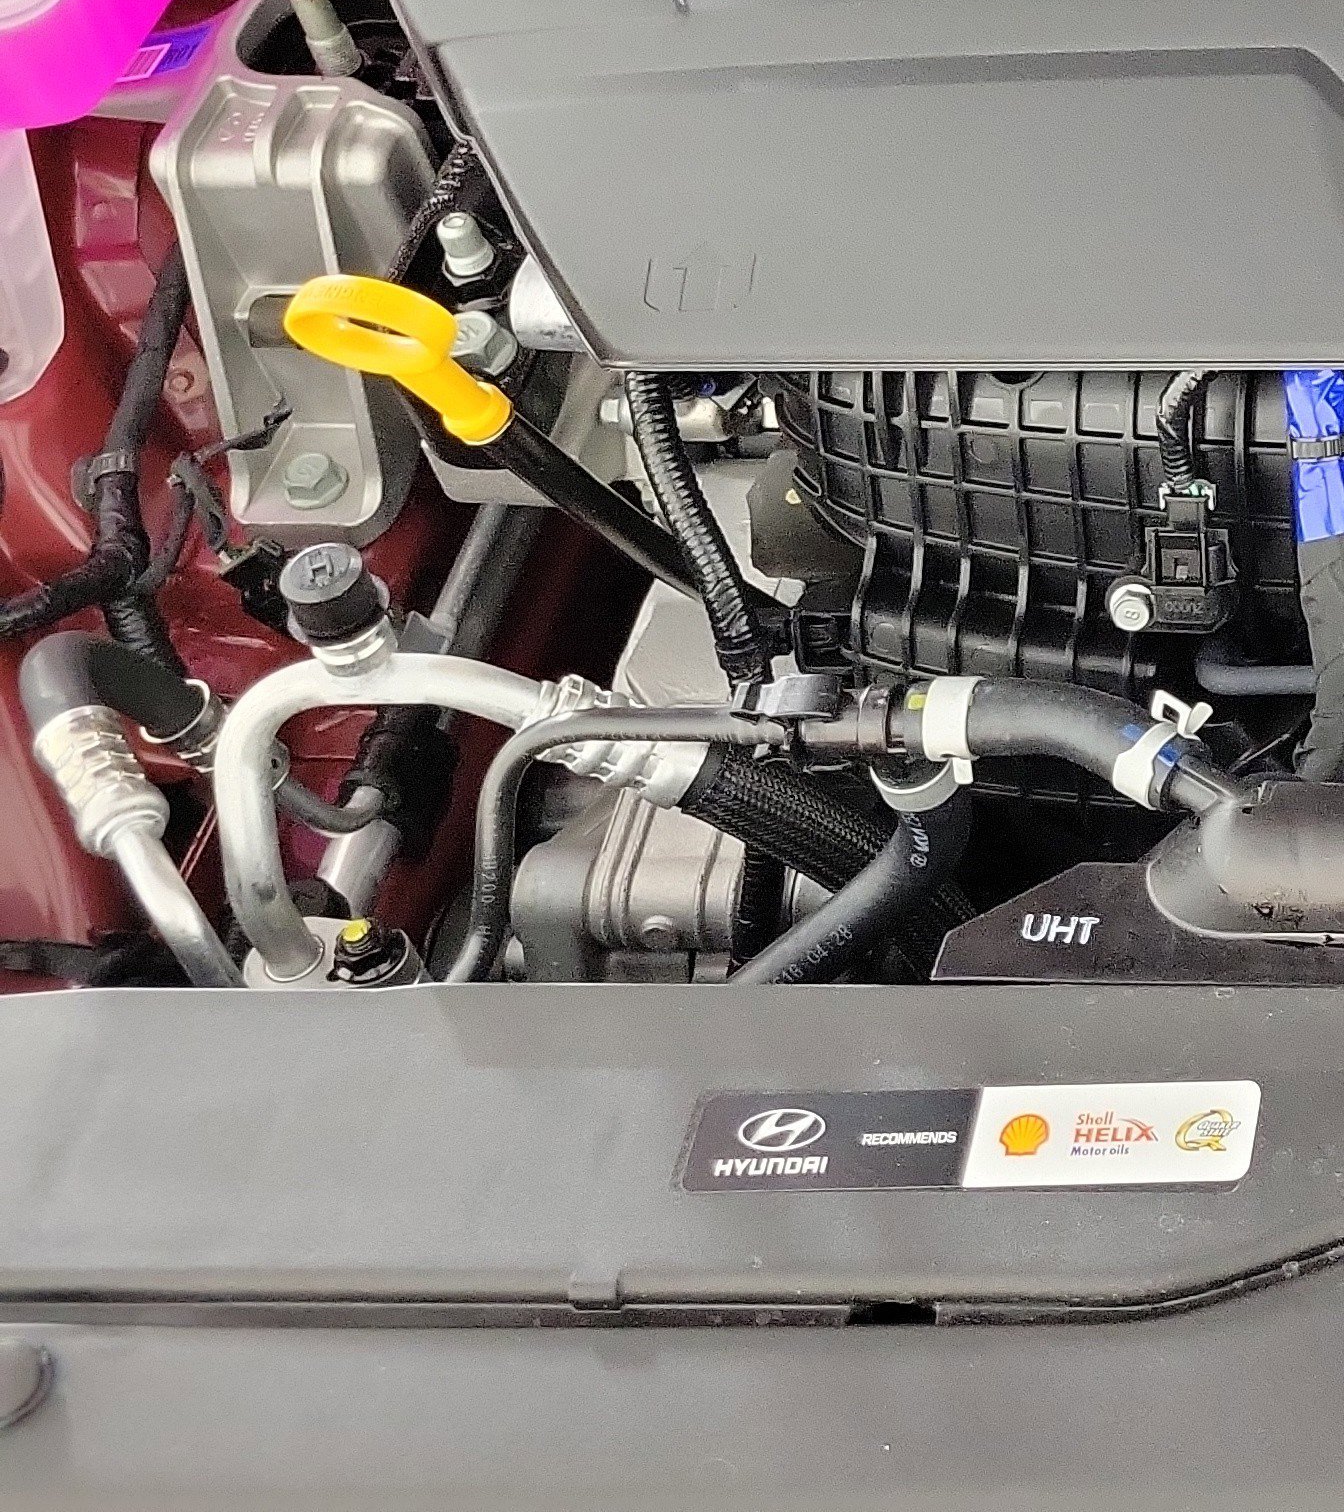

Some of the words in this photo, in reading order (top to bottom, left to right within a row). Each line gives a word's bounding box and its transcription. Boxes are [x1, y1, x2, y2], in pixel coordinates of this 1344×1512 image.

[1020, 912, 1100, 945] UHT
[1076, 1111, 1114, 1126] Shell
[861, 1131, 958, 1147] RECOMMENDS
[1073, 1125, 1157, 1143] HELIX
[1070, 1145, 1107, 1156] Motor
[1109, 1144, 1130, 1155] oils
[714, 1156, 829, 1177] HYUNDAI
